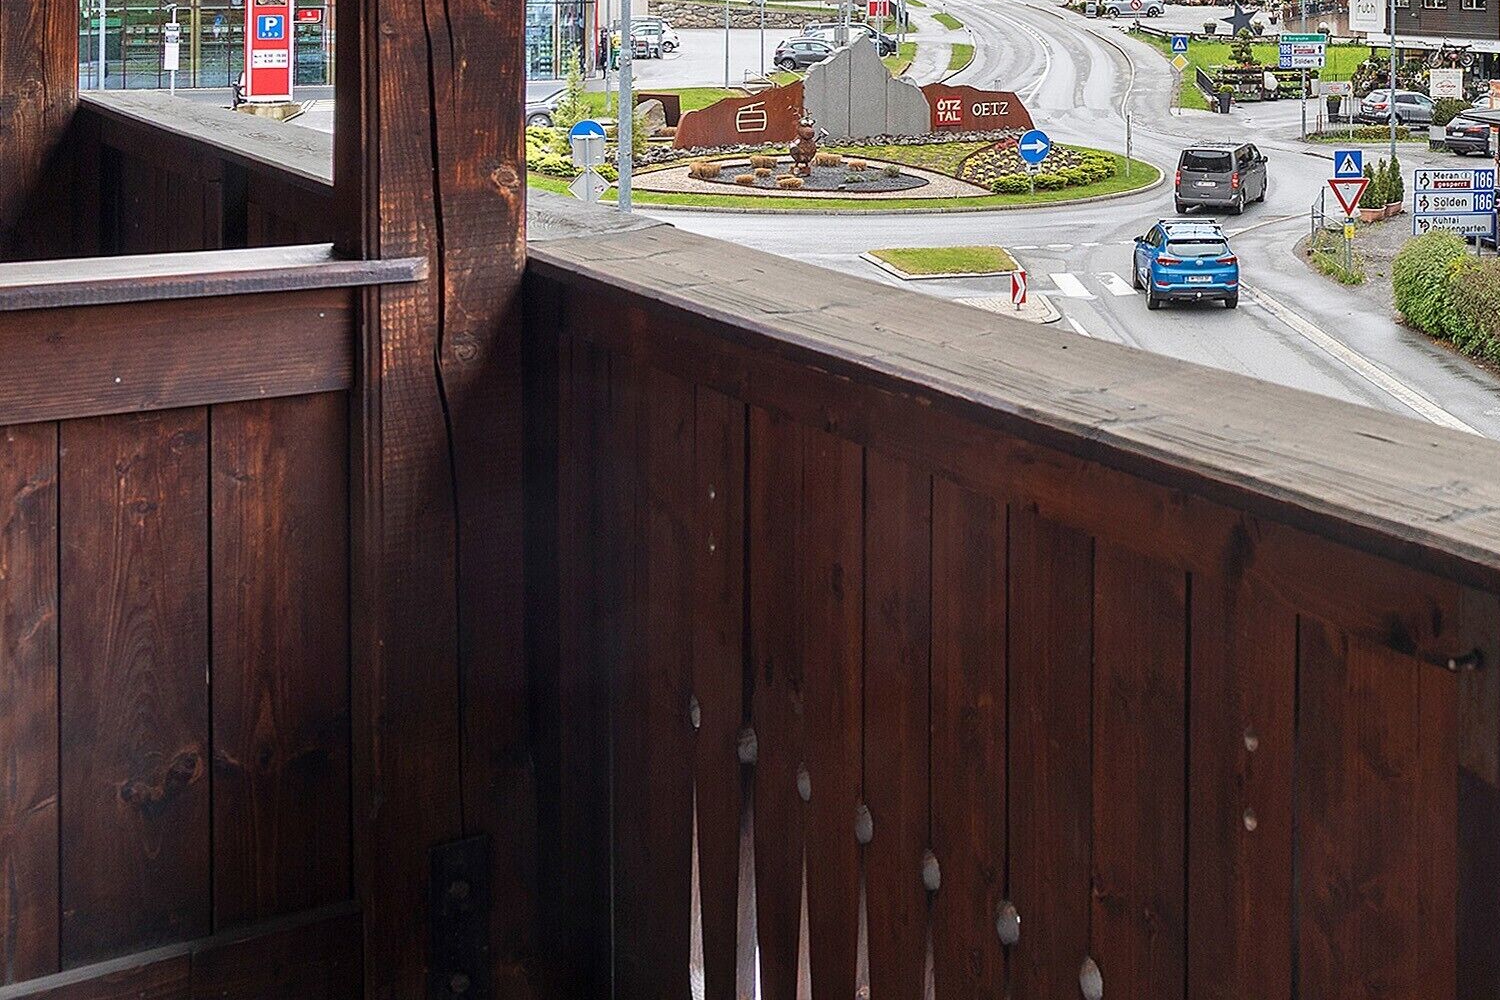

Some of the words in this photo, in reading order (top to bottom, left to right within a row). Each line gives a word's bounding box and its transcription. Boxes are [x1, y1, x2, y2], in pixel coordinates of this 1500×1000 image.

[264, 17, 279, 32] P
[937, 111, 961, 122] TAL
[1433, 171, 1460, 180] Meran
[1474, 171, 1493, 189] 186
[1437, 181, 1468, 189] gesperrt
[1433, 196, 1468, 207] Sölden
[1473, 193, 1493, 211] 186
